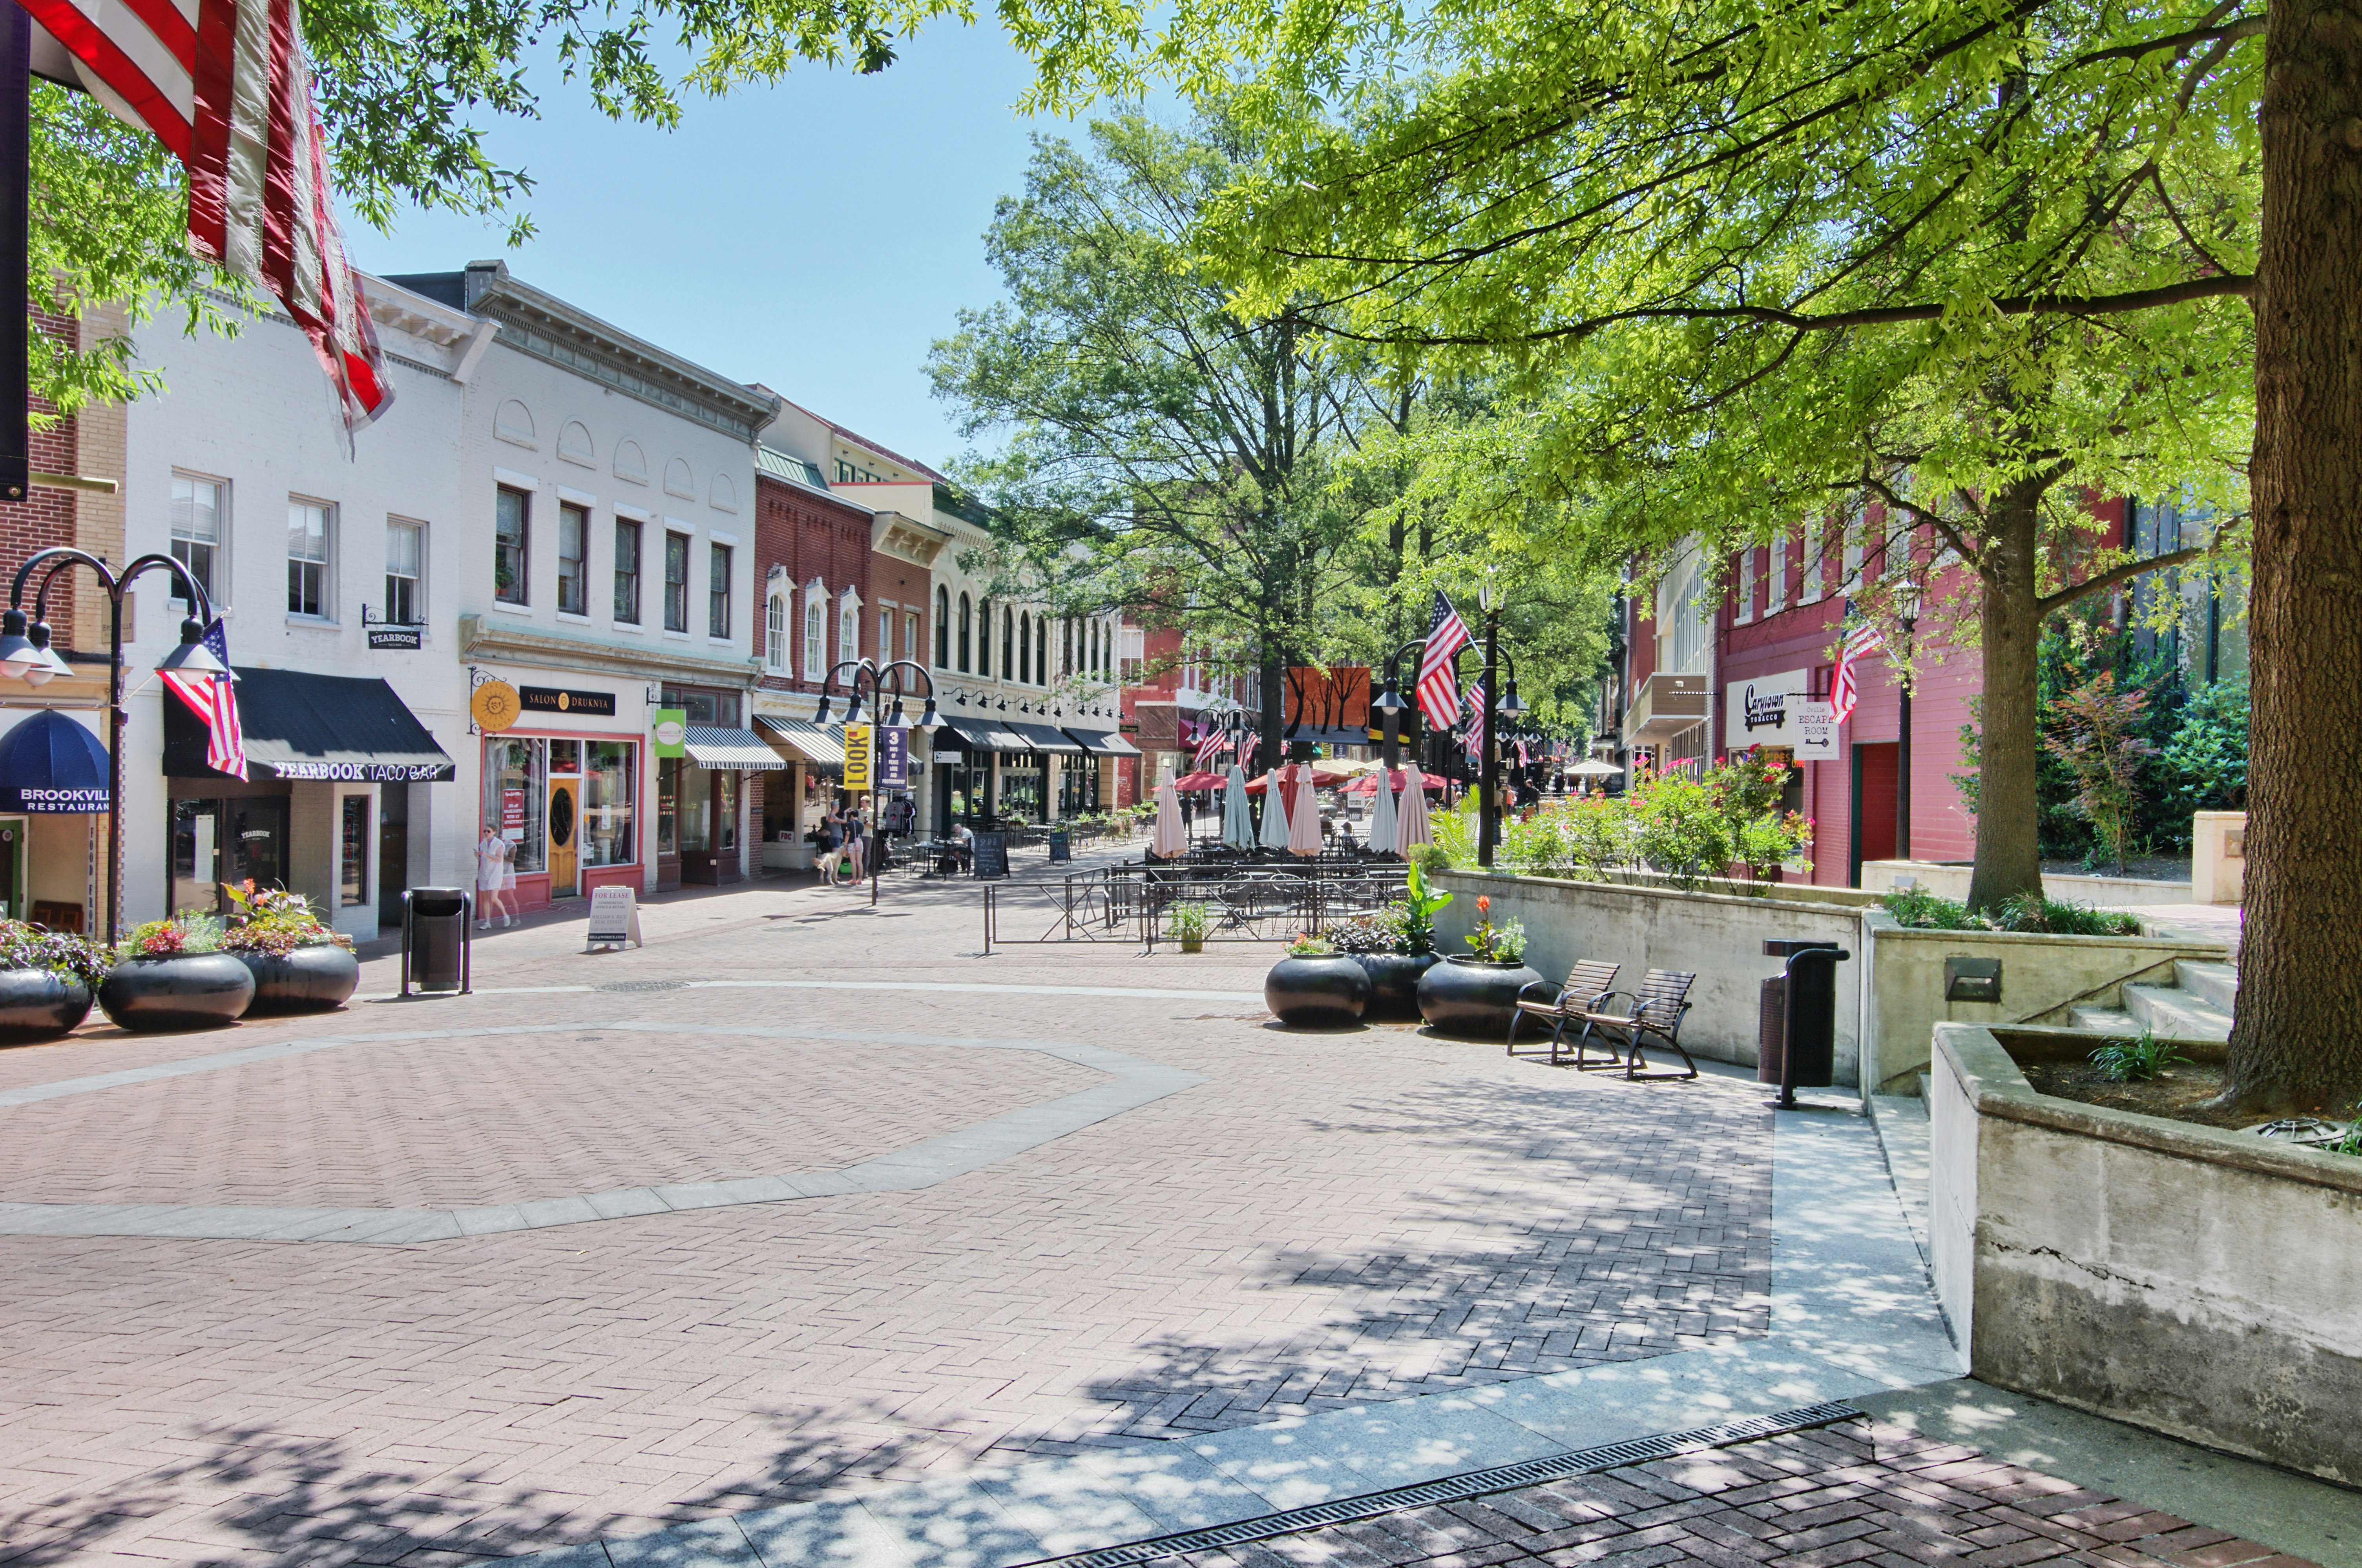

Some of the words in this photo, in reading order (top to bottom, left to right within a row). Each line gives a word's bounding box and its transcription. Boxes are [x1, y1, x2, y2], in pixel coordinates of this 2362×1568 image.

[371, 634, 418, 644] YEARBOOK
[485, 684, 510, 692] SALON
[530, 694, 556, 704] SALON
[572, 697, 608, 708] DRUKNYA
[1745, 684, 1784, 716] Carytown
[479, 716, 511, 728] DRUKNYA
[1751, 714, 1777, 722] TOBACCO
[889, 732, 898, 745] 3
[1764, 753, 1790, 762] PPES
[274, 762, 365, 780] YEARBOOK
[368, 764, 406, 780] TACO
[409, 765, 437, 780] BAR
[21, 789, 110, 800] BROOKVILL
[241, 830, 270, 839] YEARBOOK
